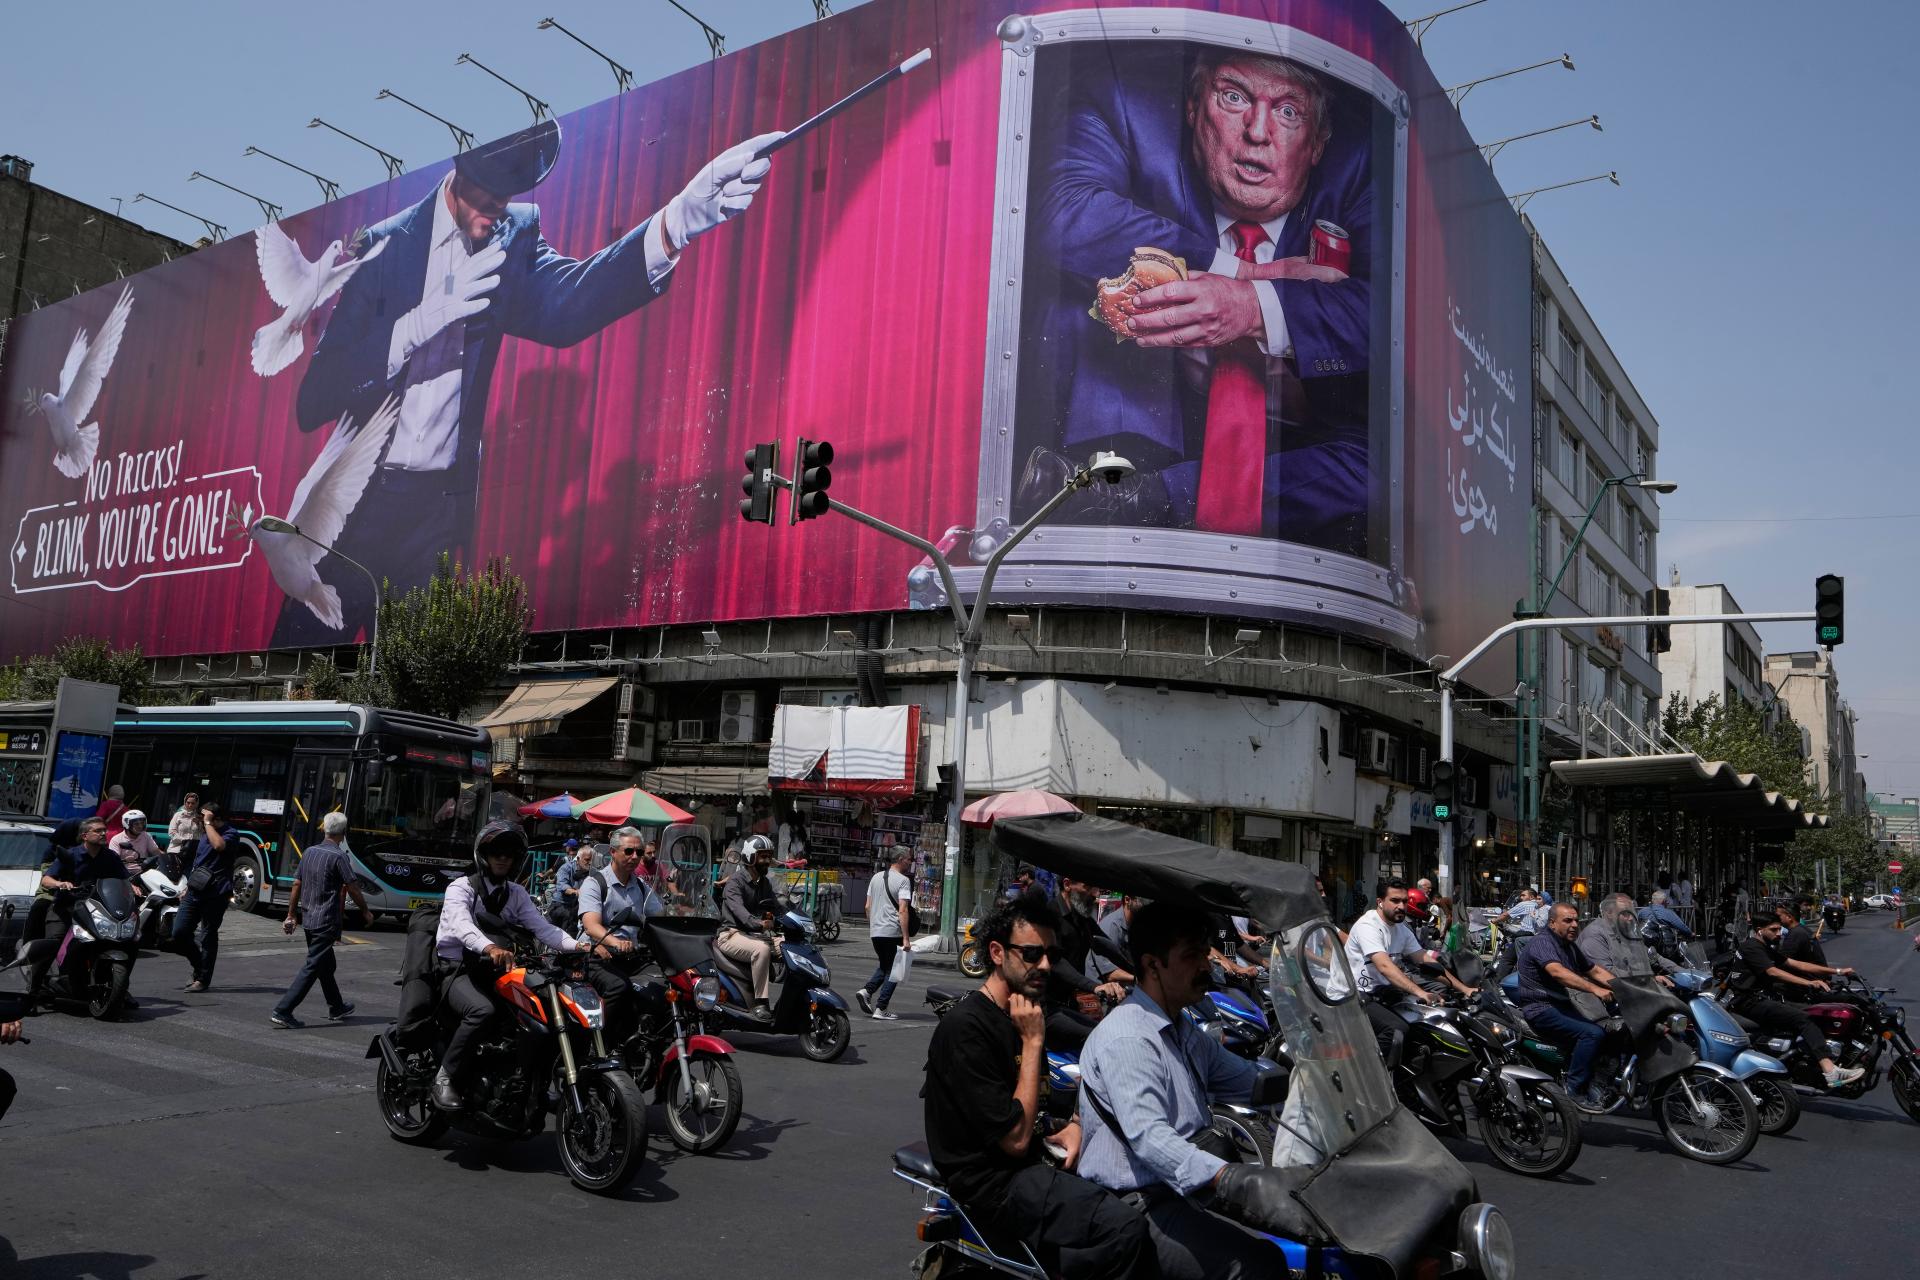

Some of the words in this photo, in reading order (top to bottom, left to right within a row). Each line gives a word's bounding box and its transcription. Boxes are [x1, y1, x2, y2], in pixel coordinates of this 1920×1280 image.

[1448, 295, 1486, 371] نیست!
[1448, 370, 1484, 455] بزنی
[1486, 349, 1516, 403] شعبده
[84, 459, 111, 504] NO
[116, 439, 183, 496] TRICKS!
[1485, 401, 1516, 493] پلک
[33, 513, 90, 578] BLINK,
[97, 501, 162, 570] YOU'RE
[163, 488, 231, 562] GONE!
[1447, 447, 1498, 536] محوی!
